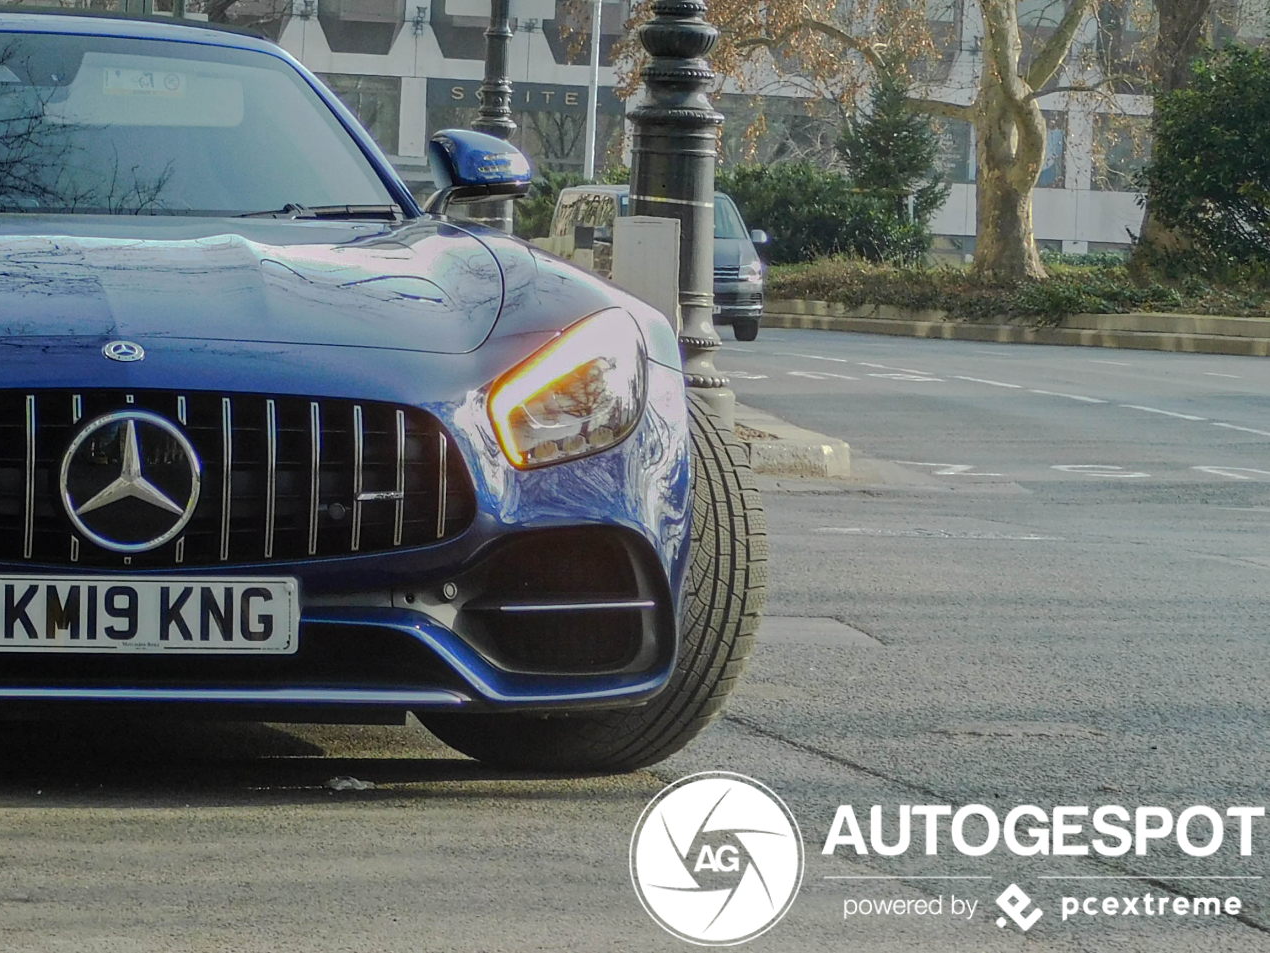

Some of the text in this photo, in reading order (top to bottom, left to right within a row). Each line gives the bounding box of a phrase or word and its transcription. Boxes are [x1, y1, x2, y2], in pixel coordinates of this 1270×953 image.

[451, 86, 601, 106] SITE
[4, 584, 138, 640] KM19
[159, 586, 273, 641] KNG
